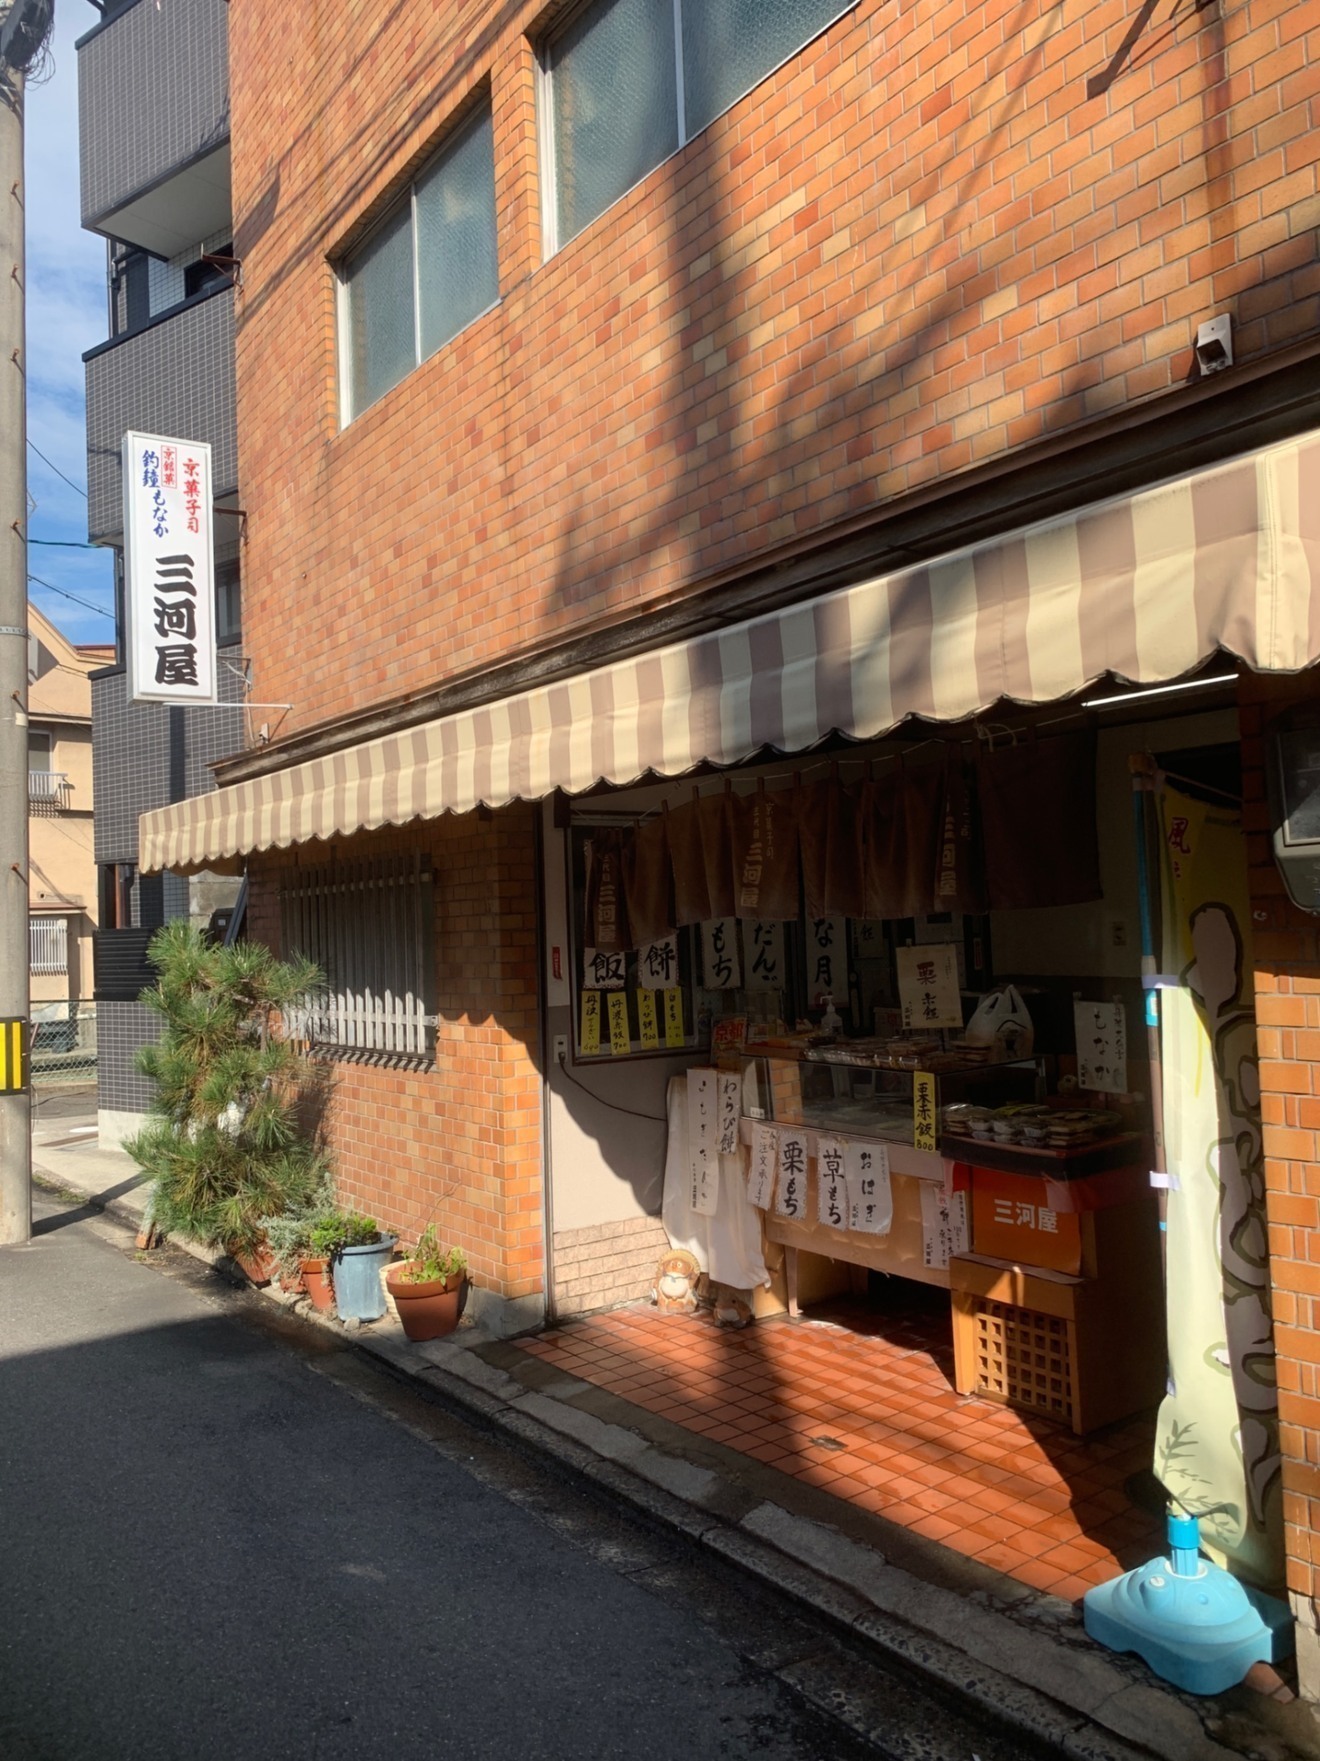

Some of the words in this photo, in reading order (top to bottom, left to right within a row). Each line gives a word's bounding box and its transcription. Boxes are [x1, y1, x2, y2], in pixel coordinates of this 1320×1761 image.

[182, 457, 202, 534] 京菓子司
[153, 553, 200, 687] 三河屋
[740, 841, 764, 908] 三河屋
[588, 952, 625, 983] 飯
[643, 941, 676, 981] 餅
[752, 921, 778, 983] だんご
[719, 1079, 738, 1154] わらび餅
[916, 1082, 934, 1138] 栗赤飯
[781, 1140, 804, 1216] 栗もち
[822, 1148, 845, 1225] 草もち
[993, 1198, 1060, 1235] 三河屋
